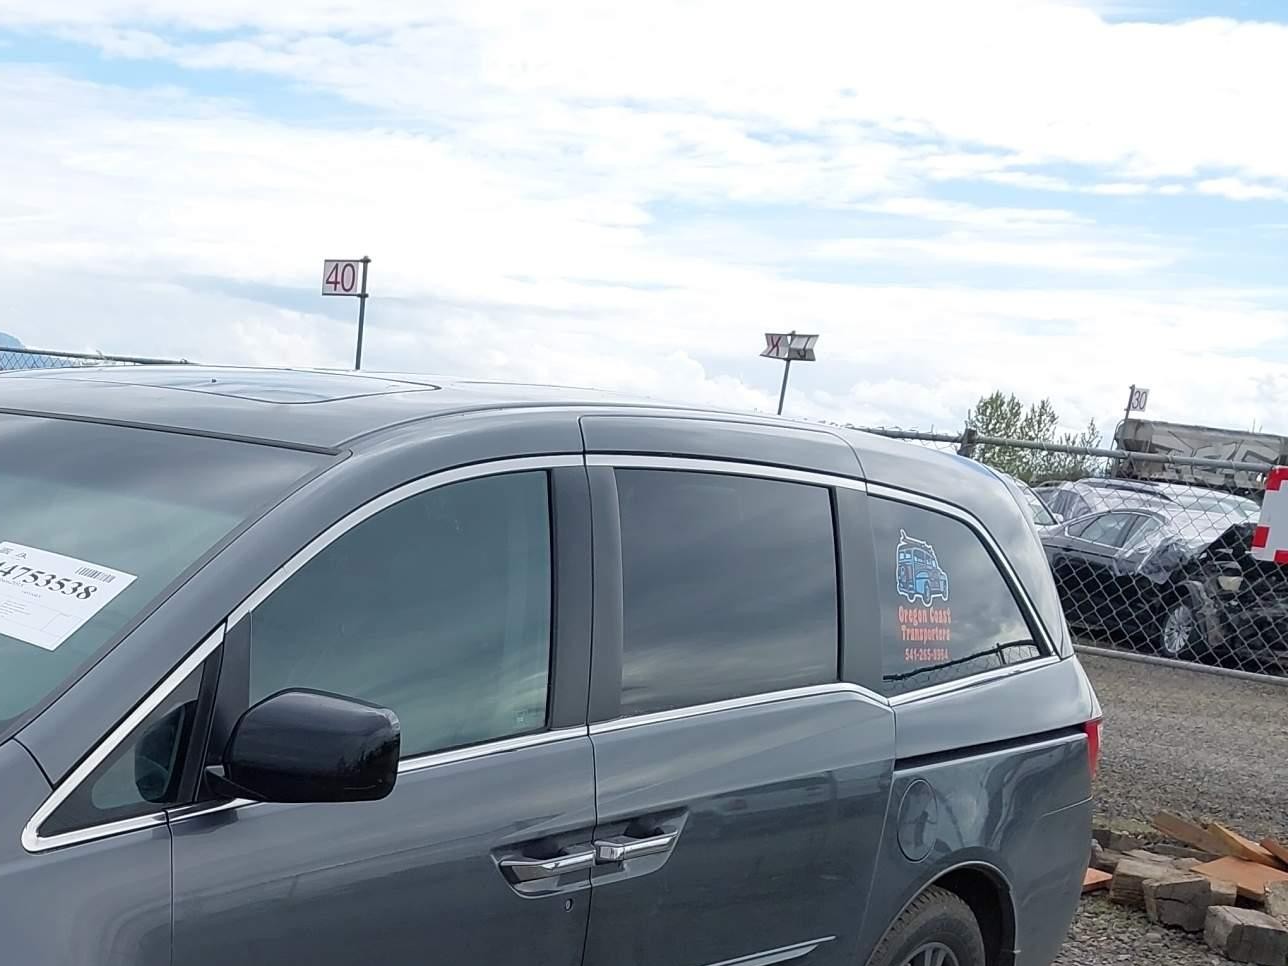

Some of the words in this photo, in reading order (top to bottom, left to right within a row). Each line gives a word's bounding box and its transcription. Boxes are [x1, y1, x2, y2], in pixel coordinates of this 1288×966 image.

[326, 263, 355, 292] 40
[1132, 391, 1147, 409] 30
[898, 606, 927, 626] Oregon
[929, 607, 951, 625] Coast
[901, 625, 950, 645] Transporters
